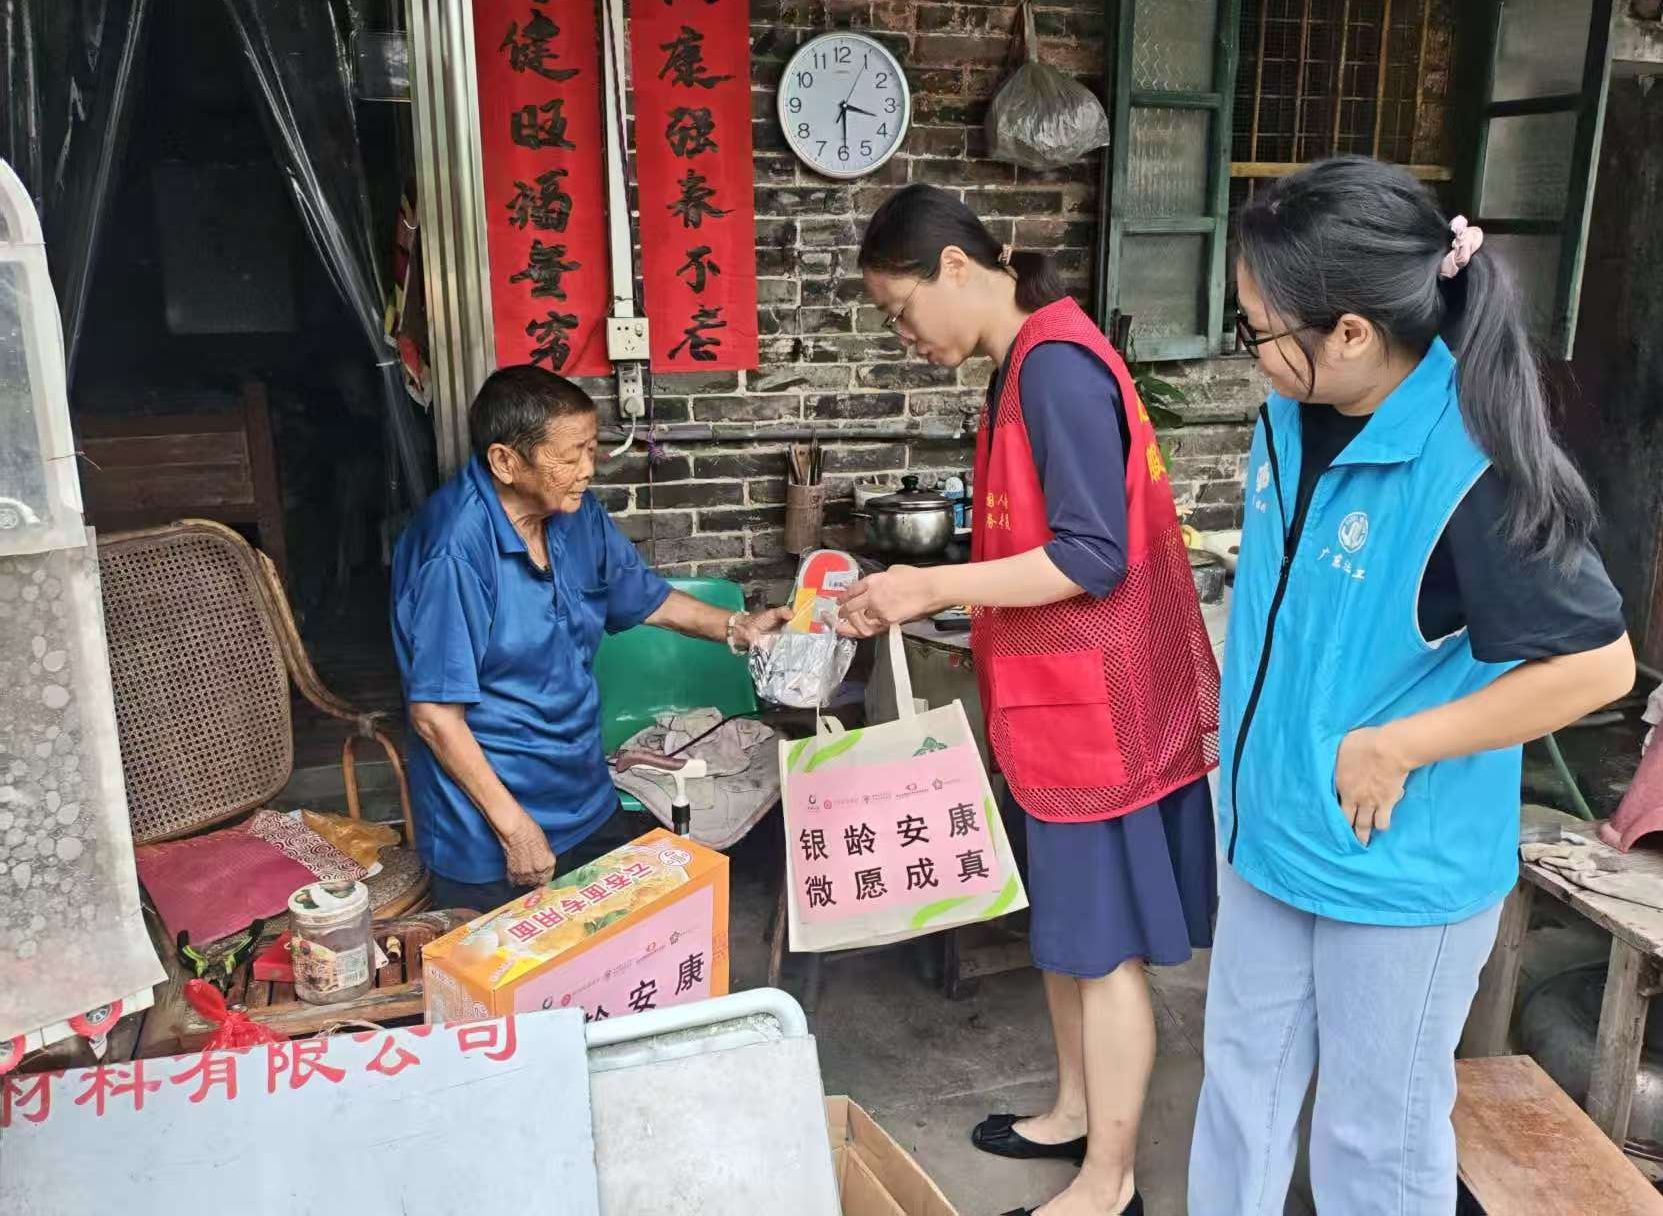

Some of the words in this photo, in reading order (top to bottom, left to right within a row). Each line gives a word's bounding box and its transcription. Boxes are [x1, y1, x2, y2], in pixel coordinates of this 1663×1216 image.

[813, 53, 826, 70] 11
[834, 46, 852, 63] 12
[863, 53, 868, 70] 1
[797, 71, 813, 88] 10
[875, 72, 888, 89] 2
[789, 97, 802, 113] 9
[884, 97, 896, 113] 3
[797, 122, 810, 139] 8
[876, 122, 888, 138] 4
[815, 140, 827, 157] 7
[837, 145, 850, 161] 6
[860, 140, 872, 156] 5
[658, 0, 735, 362] 康强春不老
[799, 801, 981, 861] 银龄安康
[804, 848, 990, 908] 微愿成真
[507, 863, 653, 942] 云吞面专用面
